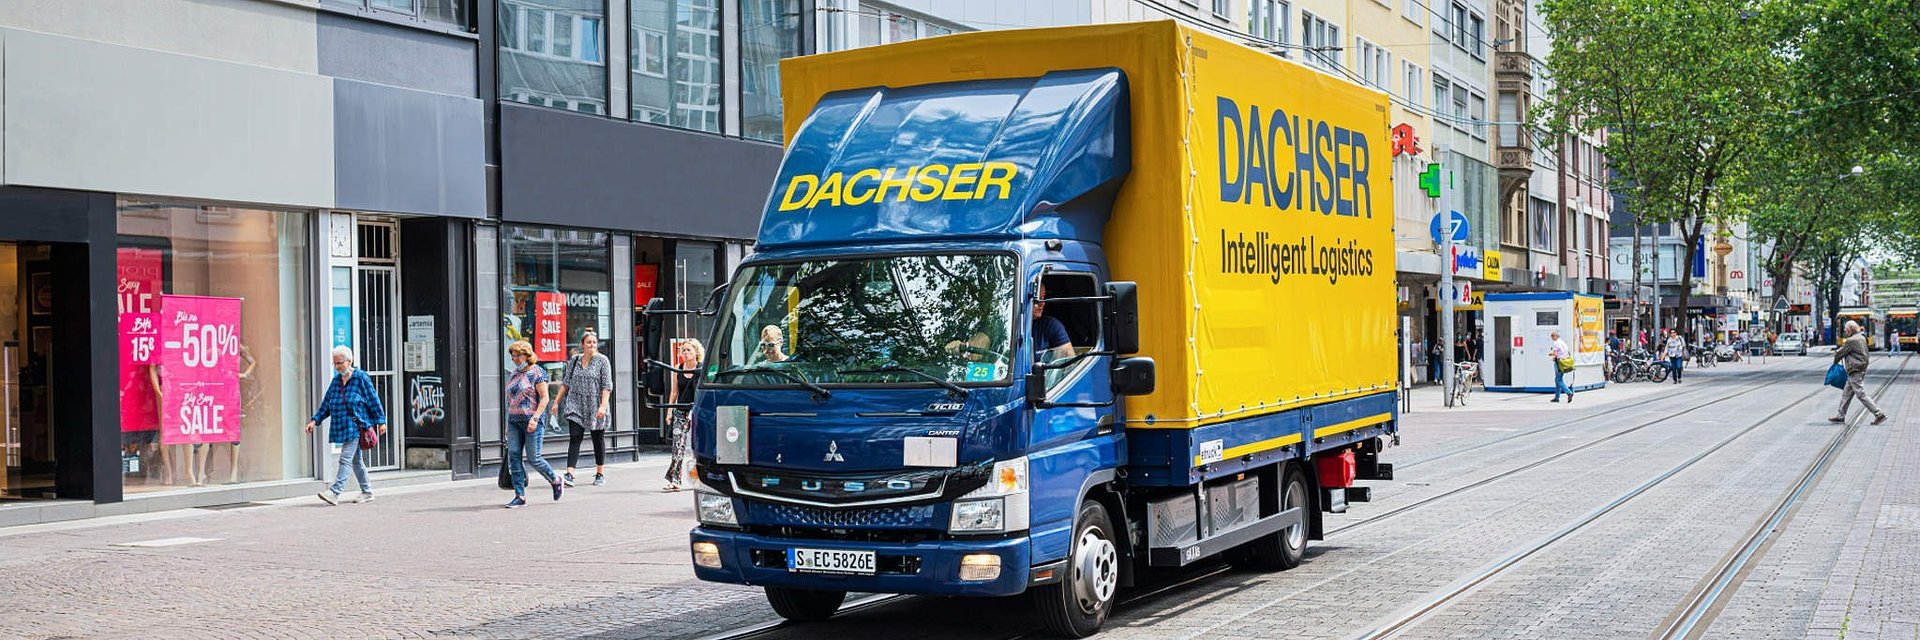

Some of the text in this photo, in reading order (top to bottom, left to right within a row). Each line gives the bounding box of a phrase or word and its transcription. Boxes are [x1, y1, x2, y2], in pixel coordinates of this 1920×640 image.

[1216, 96, 1372, 219] DACHSER
[778, 161, 1018, 212] DACHSER
[1222, 229, 1373, 286] Intelligent Logistics
[542, 300, 562, 316] SALE
[542, 319, 562, 334] SALE
[164, 323, 239, 368] -50%
[541, 338, 561, 353] SALE
[973, 367, 988, 377] 25
[180, 405, 225, 435] SALE
[761, 477, 912, 493] FUSO
[796, 550, 874, 570] S EC 5826E
